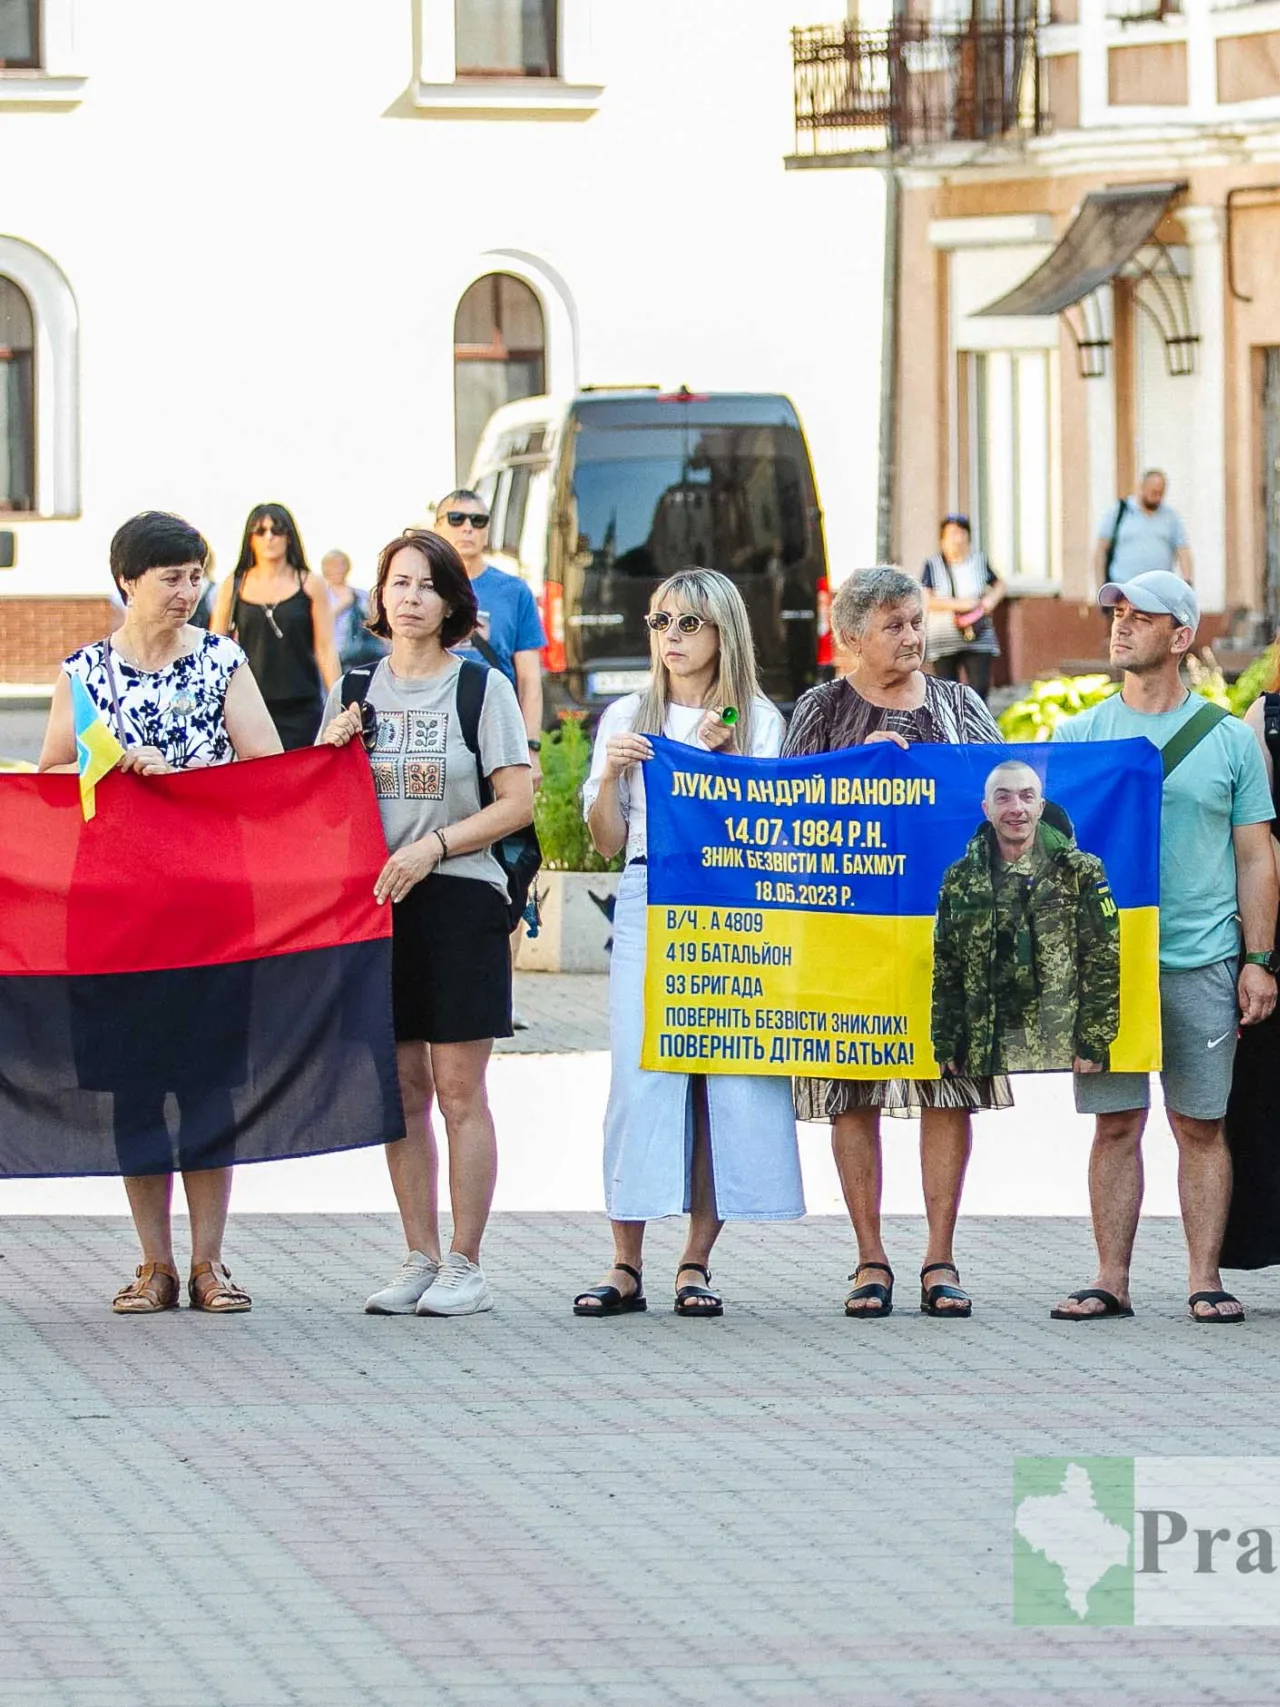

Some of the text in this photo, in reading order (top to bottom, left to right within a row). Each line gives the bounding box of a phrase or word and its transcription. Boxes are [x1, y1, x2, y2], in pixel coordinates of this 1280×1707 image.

[671, 771, 936, 806] ЛУКАЧ АНДРІЙ ІВАНОВИЧ
[848, 821, 887, 848] Р.Н.
[702, 846, 907, 876] ЗНИК БЕЗВІСТИ М. БАХМУТ
[755, 881, 855, 907] 18.05.2023 Р.
[667, 910, 697, 930] В/Ч
[724, 912, 763, 932] 4809
[666, 941, 792, 966] 419 БАТАЛЬЙОН
[666, 975, 763, 998] 93 БРИГАДА
[665, 1007, 908, 1035] ПОВЕРНІТЬ БЕЗВІСТИ ЗНИКЛИХ!
[659, 1034, 915, 1066] ПОВЕРНІТЬ ДІТЯМ БАТЬКА!
